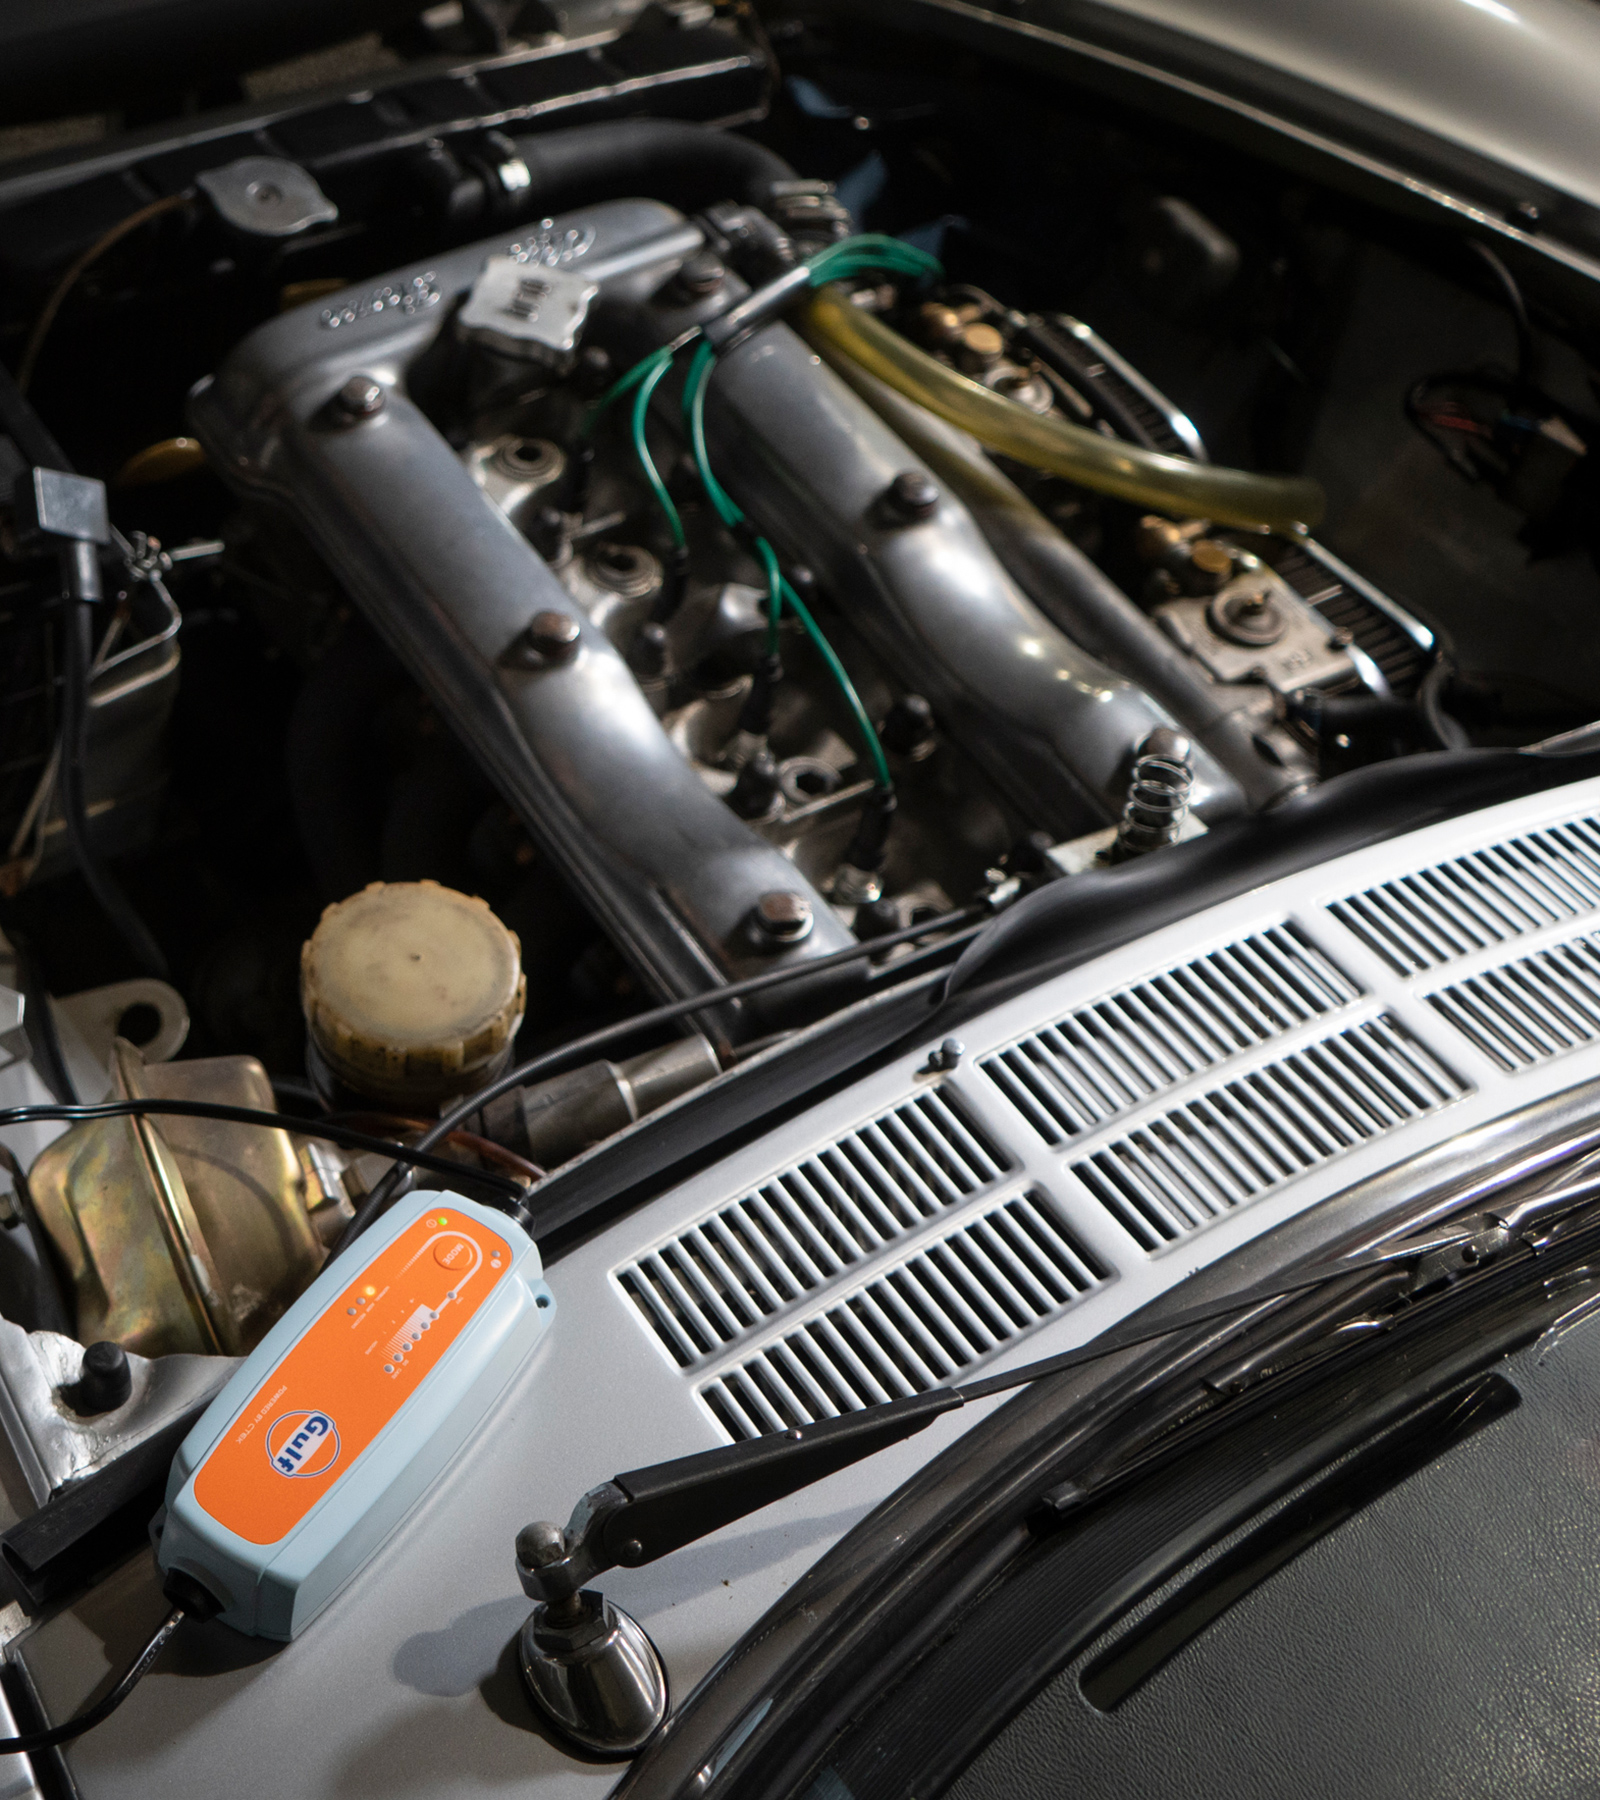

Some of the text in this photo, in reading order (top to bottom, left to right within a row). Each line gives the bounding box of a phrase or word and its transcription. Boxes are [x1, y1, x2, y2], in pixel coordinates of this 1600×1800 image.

[442, 1243, 464, 1264] MODE
[365, 1341, 377, 1355] HOURS
[236, 1385, 287, 1444] POWERED BY CTEK
[278, 1416, 329, 1472] Gulf
